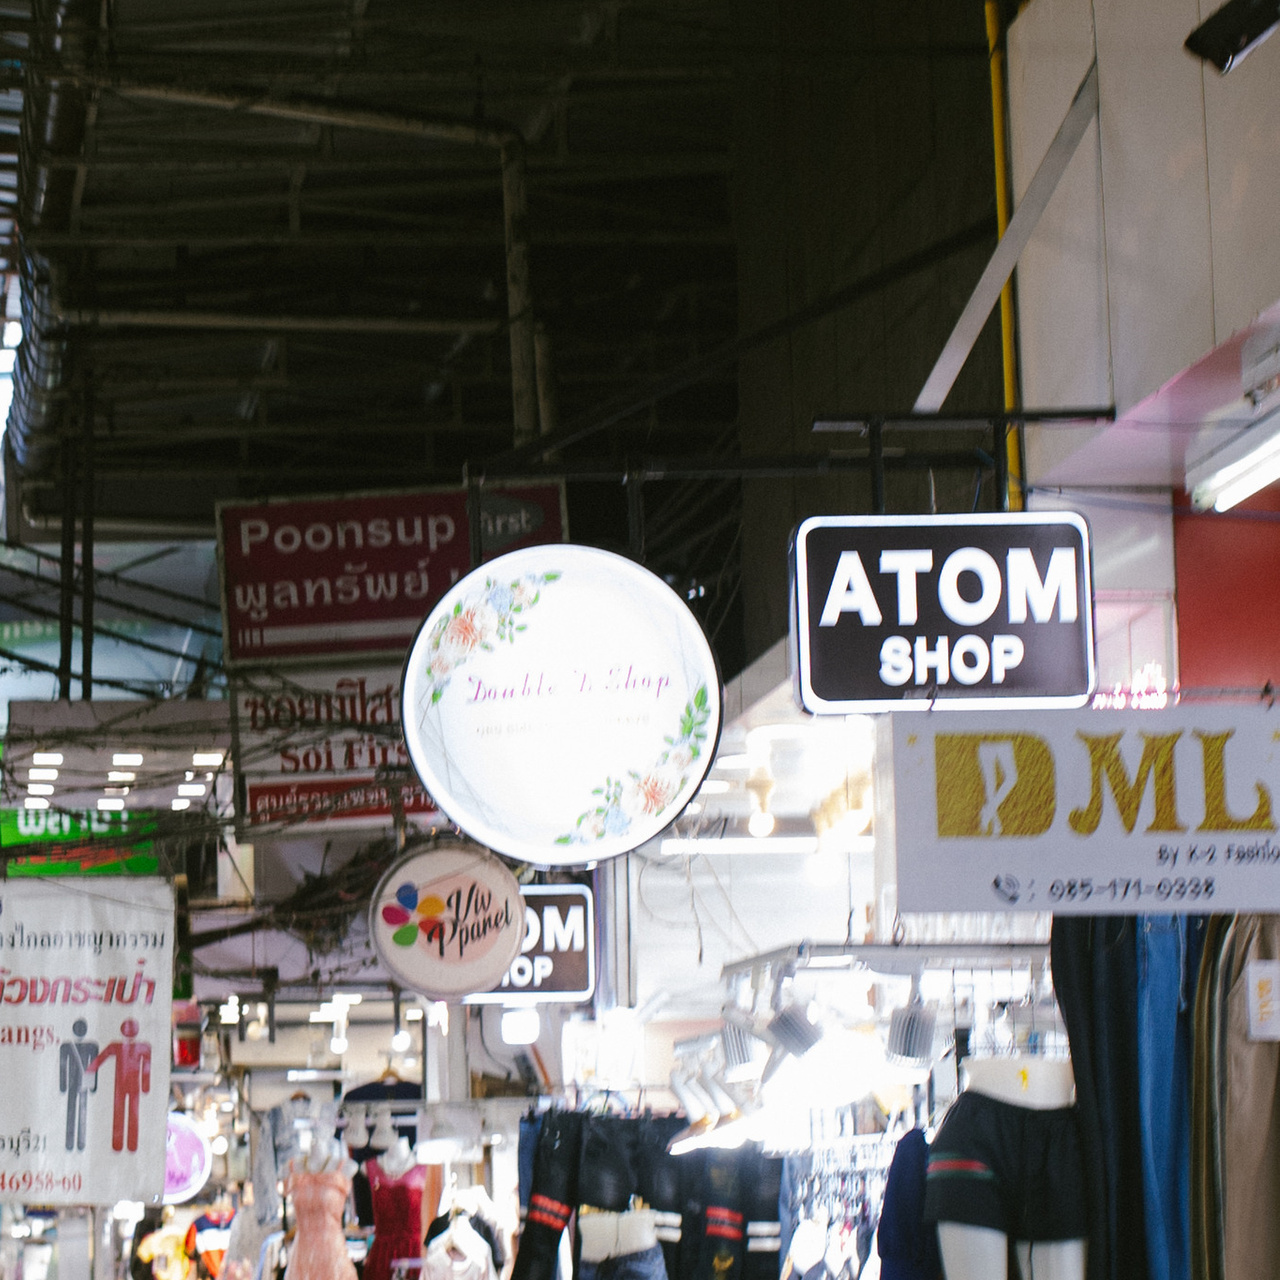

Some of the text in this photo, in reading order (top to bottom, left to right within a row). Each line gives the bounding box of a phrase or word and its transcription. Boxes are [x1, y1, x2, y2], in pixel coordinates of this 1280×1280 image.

[239, 514, 456, 556] Poonsup
[819, 547, 1078, 626] ATOM
[879, 634, 1025, 686] SHOP
[466, 671, 557, 705] Double
[280, 734, 409, 775] Soi Firs
[1157, 843, 1180, 871] By
